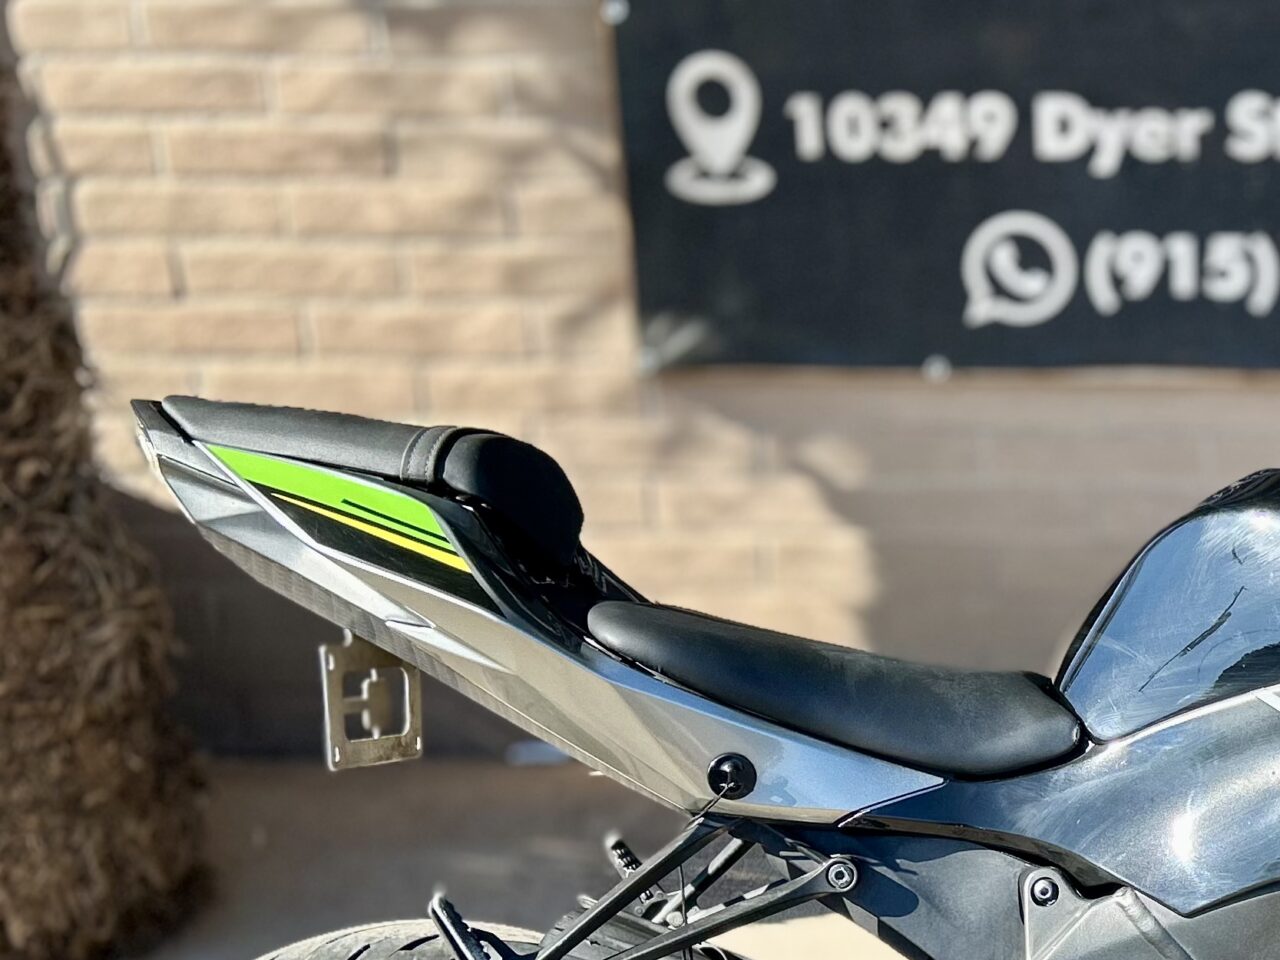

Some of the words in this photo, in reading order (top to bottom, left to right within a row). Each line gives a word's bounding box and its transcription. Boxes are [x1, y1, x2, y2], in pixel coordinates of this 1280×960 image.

[786, 90, 1018, 162] 10349
[1032, 91, 1214, 178] Dyer
[1085, 230, 1280, 316] (915)
